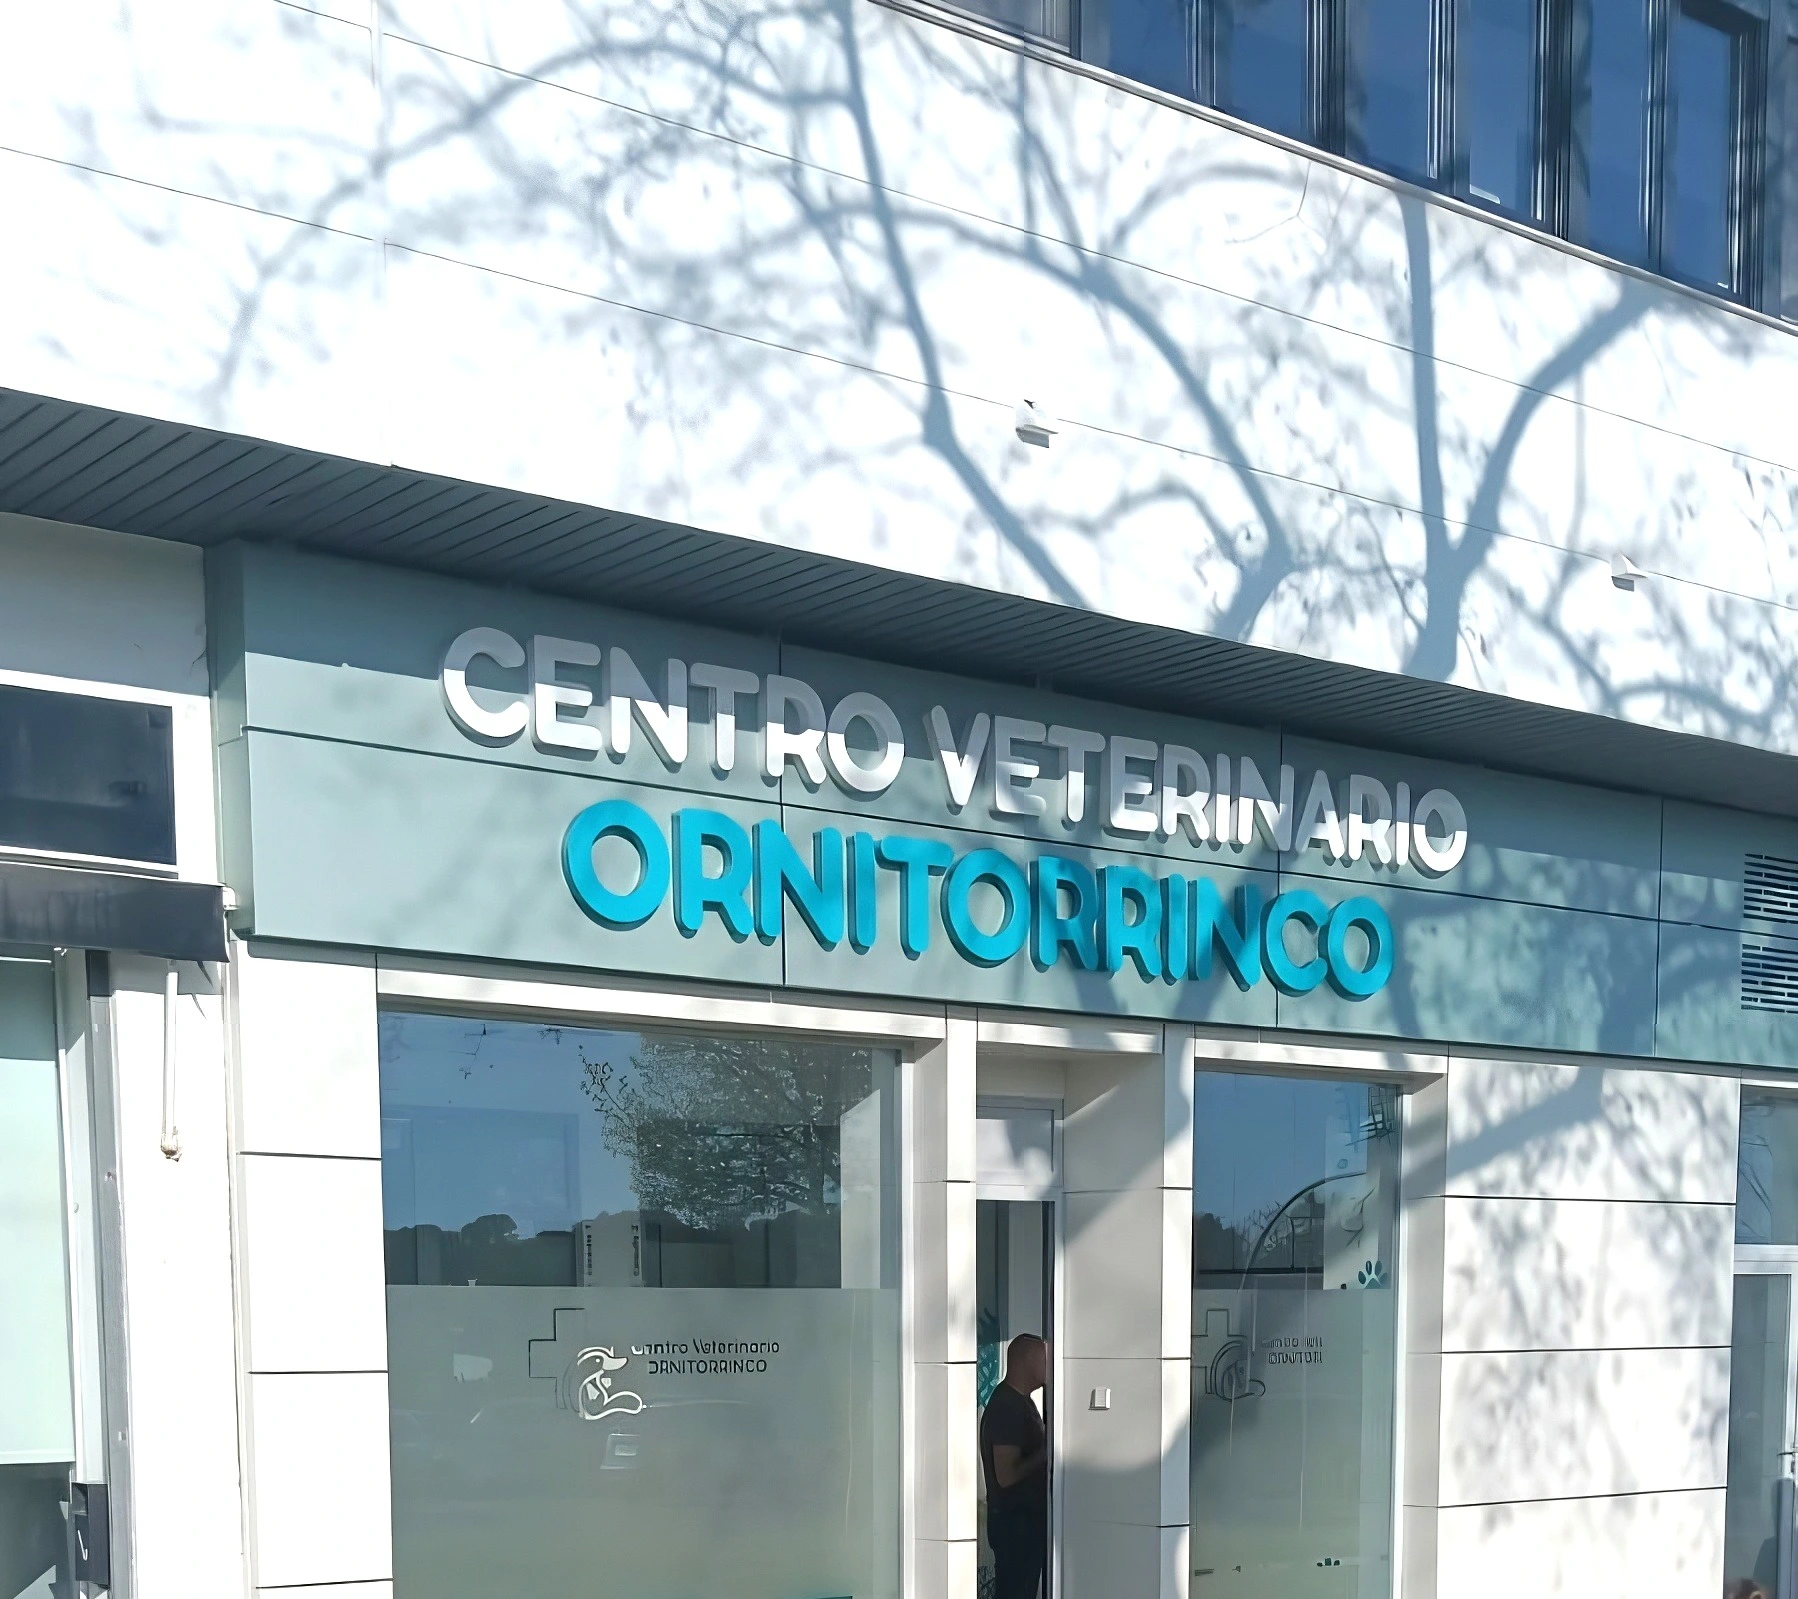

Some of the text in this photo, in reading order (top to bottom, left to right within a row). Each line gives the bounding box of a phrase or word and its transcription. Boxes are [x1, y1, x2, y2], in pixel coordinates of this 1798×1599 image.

[442, 627, 1468, 875] CENTRO VETERINARIO
[562, 799, 1395, 999] ORNITORRINCO
